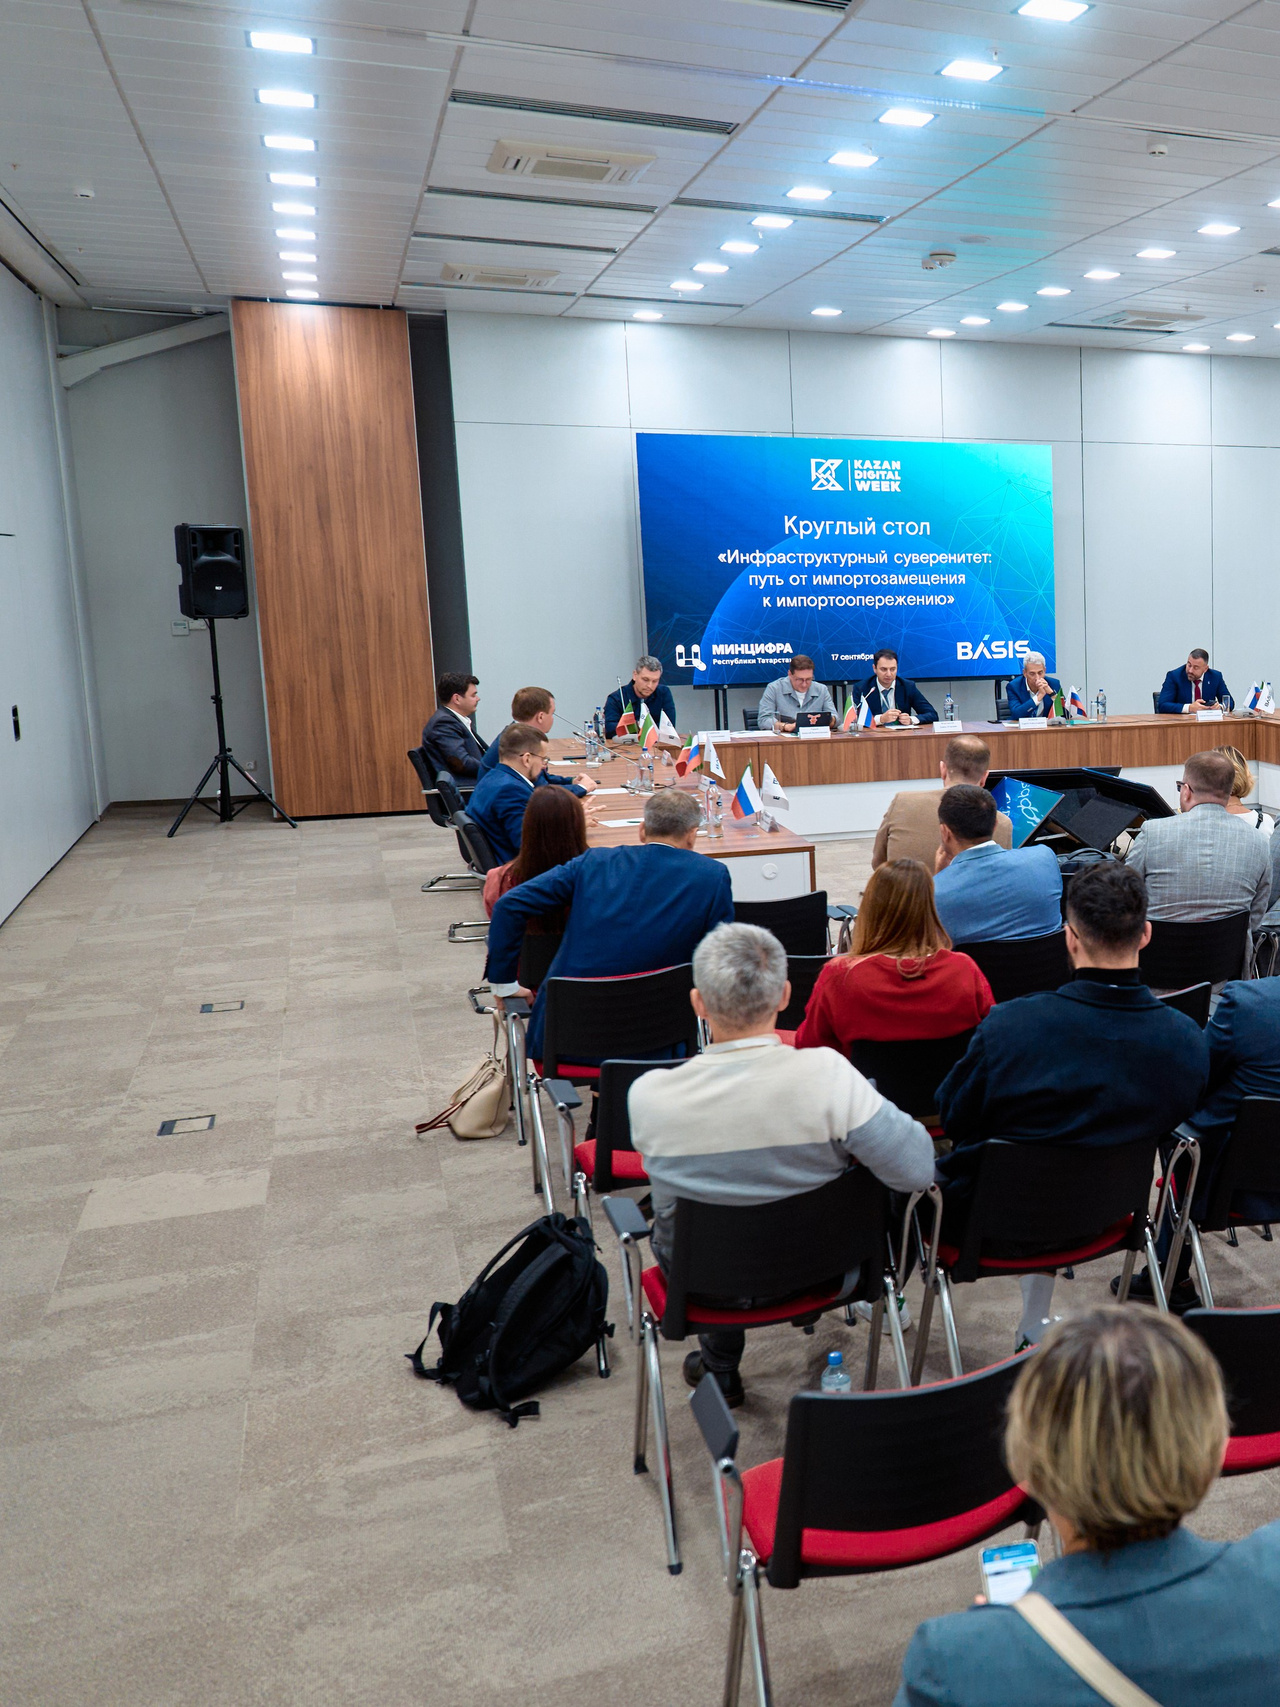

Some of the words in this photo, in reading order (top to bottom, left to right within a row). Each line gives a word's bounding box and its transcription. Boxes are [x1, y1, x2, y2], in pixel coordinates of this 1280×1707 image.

[853, 459, 901, 470] KAZAN
[854, 470, 901, 480] DIGITAL
[854, 480, 901, 492] WEEK
[784, 515, 876, 540] Круглый
[882, 520, 931, 536] стол
[717, 549, 888, 567] «Инфраструктурный
[893, 552, 992, 567] суверенитет:
[748, 574, 785, 589] путь
[788, 574, 808, 586] от
[812, 573, 966, 588] импортозамещения
[762, 596, 772, 608] к
[776, 594, 955, 611] импортоопережению»
[712, 642, 794, 656] МИНЦИФРА
[712, 657, 757, 666] Республики
[831, 653, 839, 661] 17
[839, 652, 874, 661] сентября
